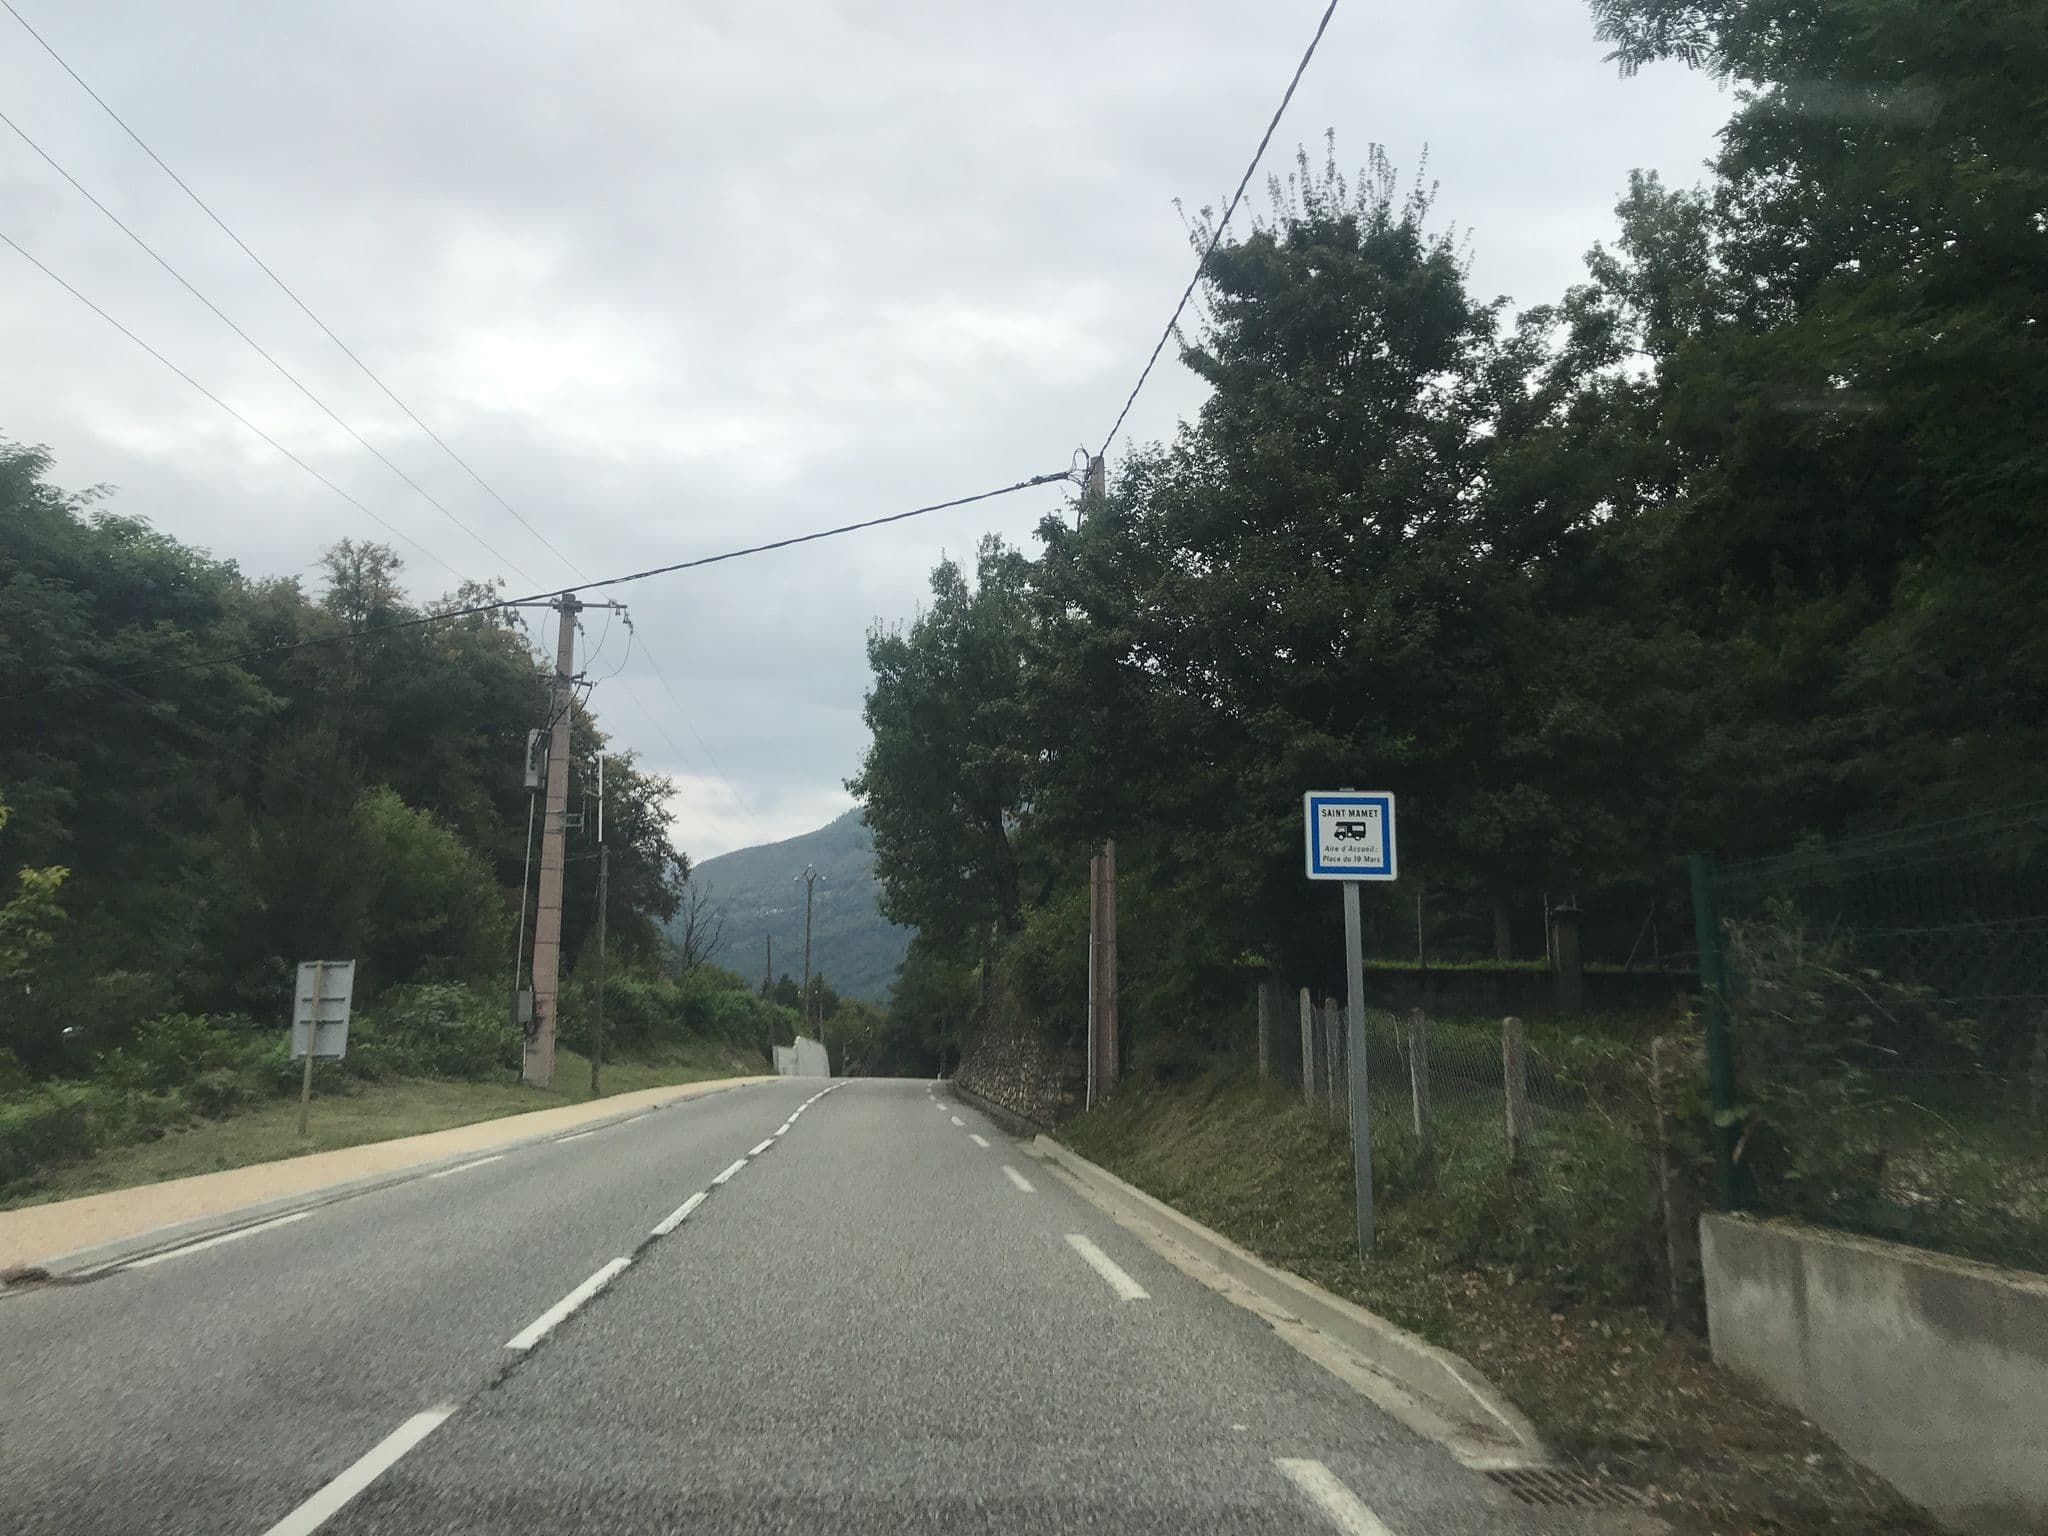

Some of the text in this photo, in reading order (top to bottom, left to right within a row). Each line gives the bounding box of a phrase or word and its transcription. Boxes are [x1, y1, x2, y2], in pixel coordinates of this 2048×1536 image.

[1321, 809, 1378, 817] SAINT MAMET
[1364, 855, 1380, 863] Mars
